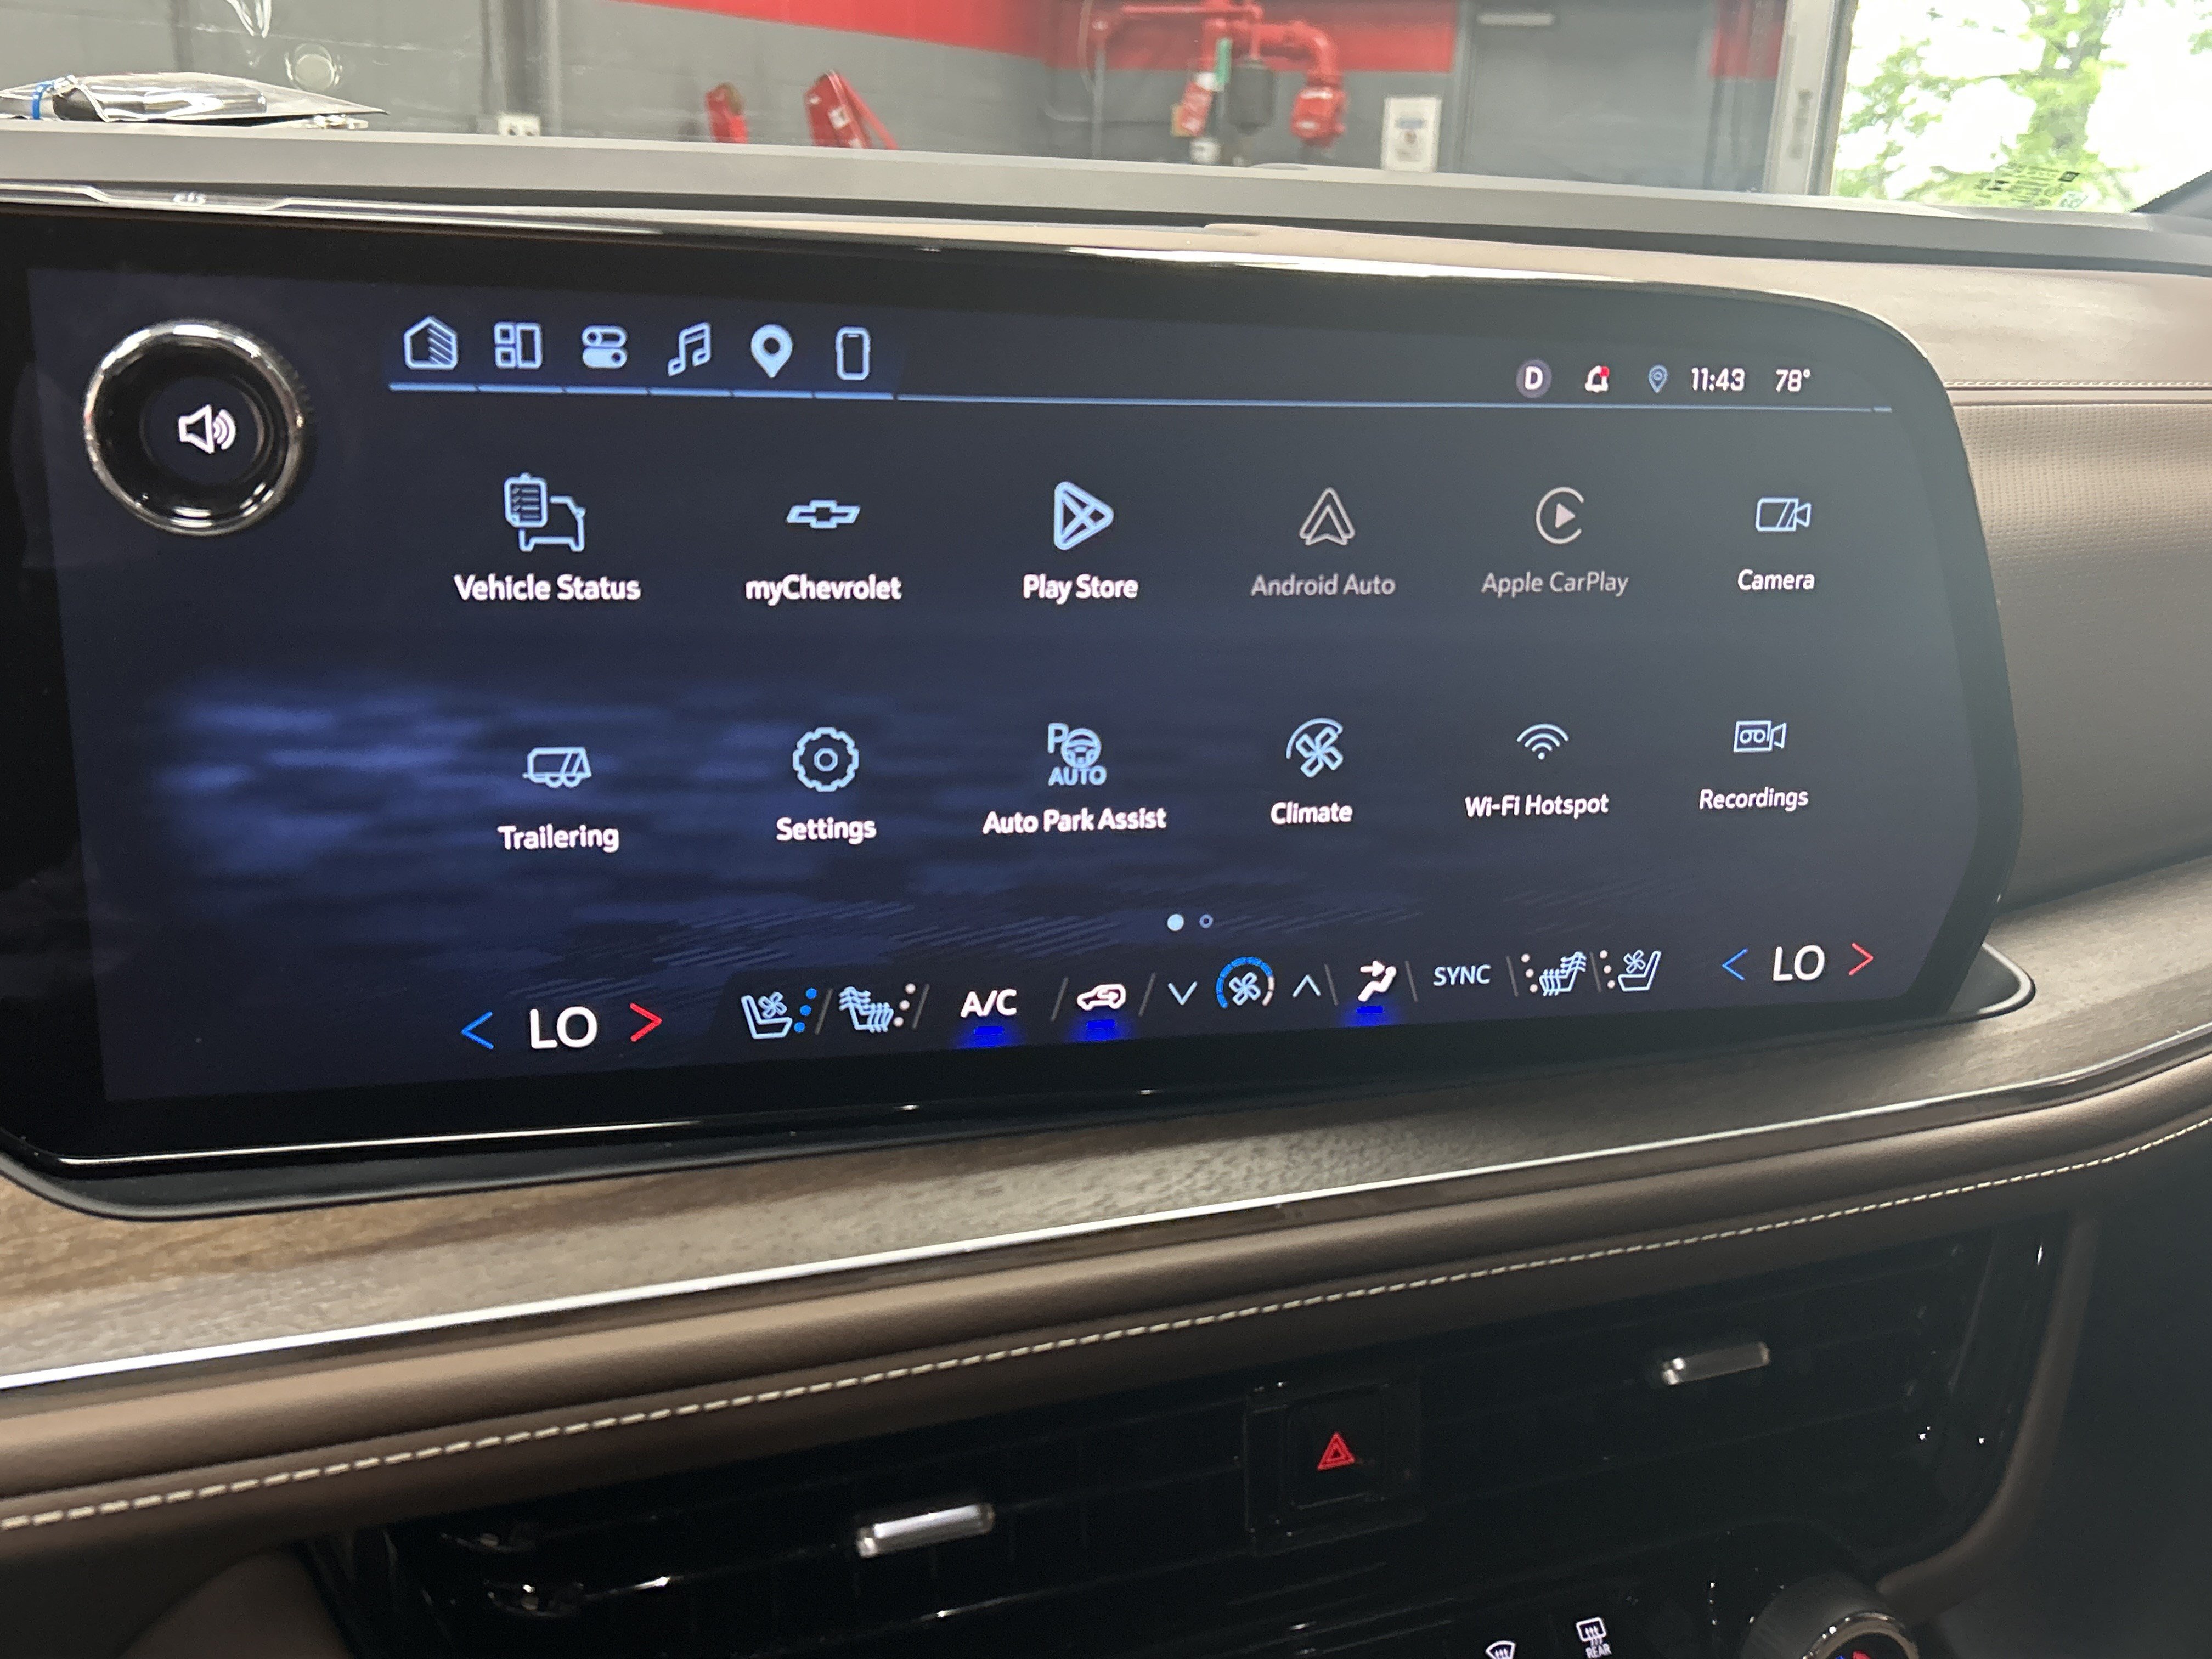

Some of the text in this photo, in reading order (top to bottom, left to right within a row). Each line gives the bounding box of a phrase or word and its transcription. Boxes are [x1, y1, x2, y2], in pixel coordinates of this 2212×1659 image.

[1525, 366, 1543, 390] D
[1691, 367, 1745, 392] 11:43
[1776, 369, 1811, 392] 78°
[453, 573, 641, 601] Vehicle Status
[746, 573, 902, 606] myChevrolet
[1023, 573, 1139, 605] Play Store
[1251, 573, 1396, 596] Android Auto
[1481, 570, 1629, 598] Apple CarPlay
[1737, 568, 1815, 591] Camera
[1047, 766, 1107, 786] AUTO
[1271, 800, 1353, 825] Climate
[1465, 793, 1609, 820] Wi-Fi Hotspot
[1699, 786, 1808, 812] Recordings
[776, 816, 877, 845] Settings
[982, 807, 1167, 834] Auto Park Assist
[496, 823, 619, 853] Trailering
[1433, 964, 1491, 986] SYNC
[1773, 945, 1825, 981] LO
[960, 989, 1017, 1018] A/C
[529, 1006, 597, 1049] LO
[1585, 1643, 1612, 1659] REAR
